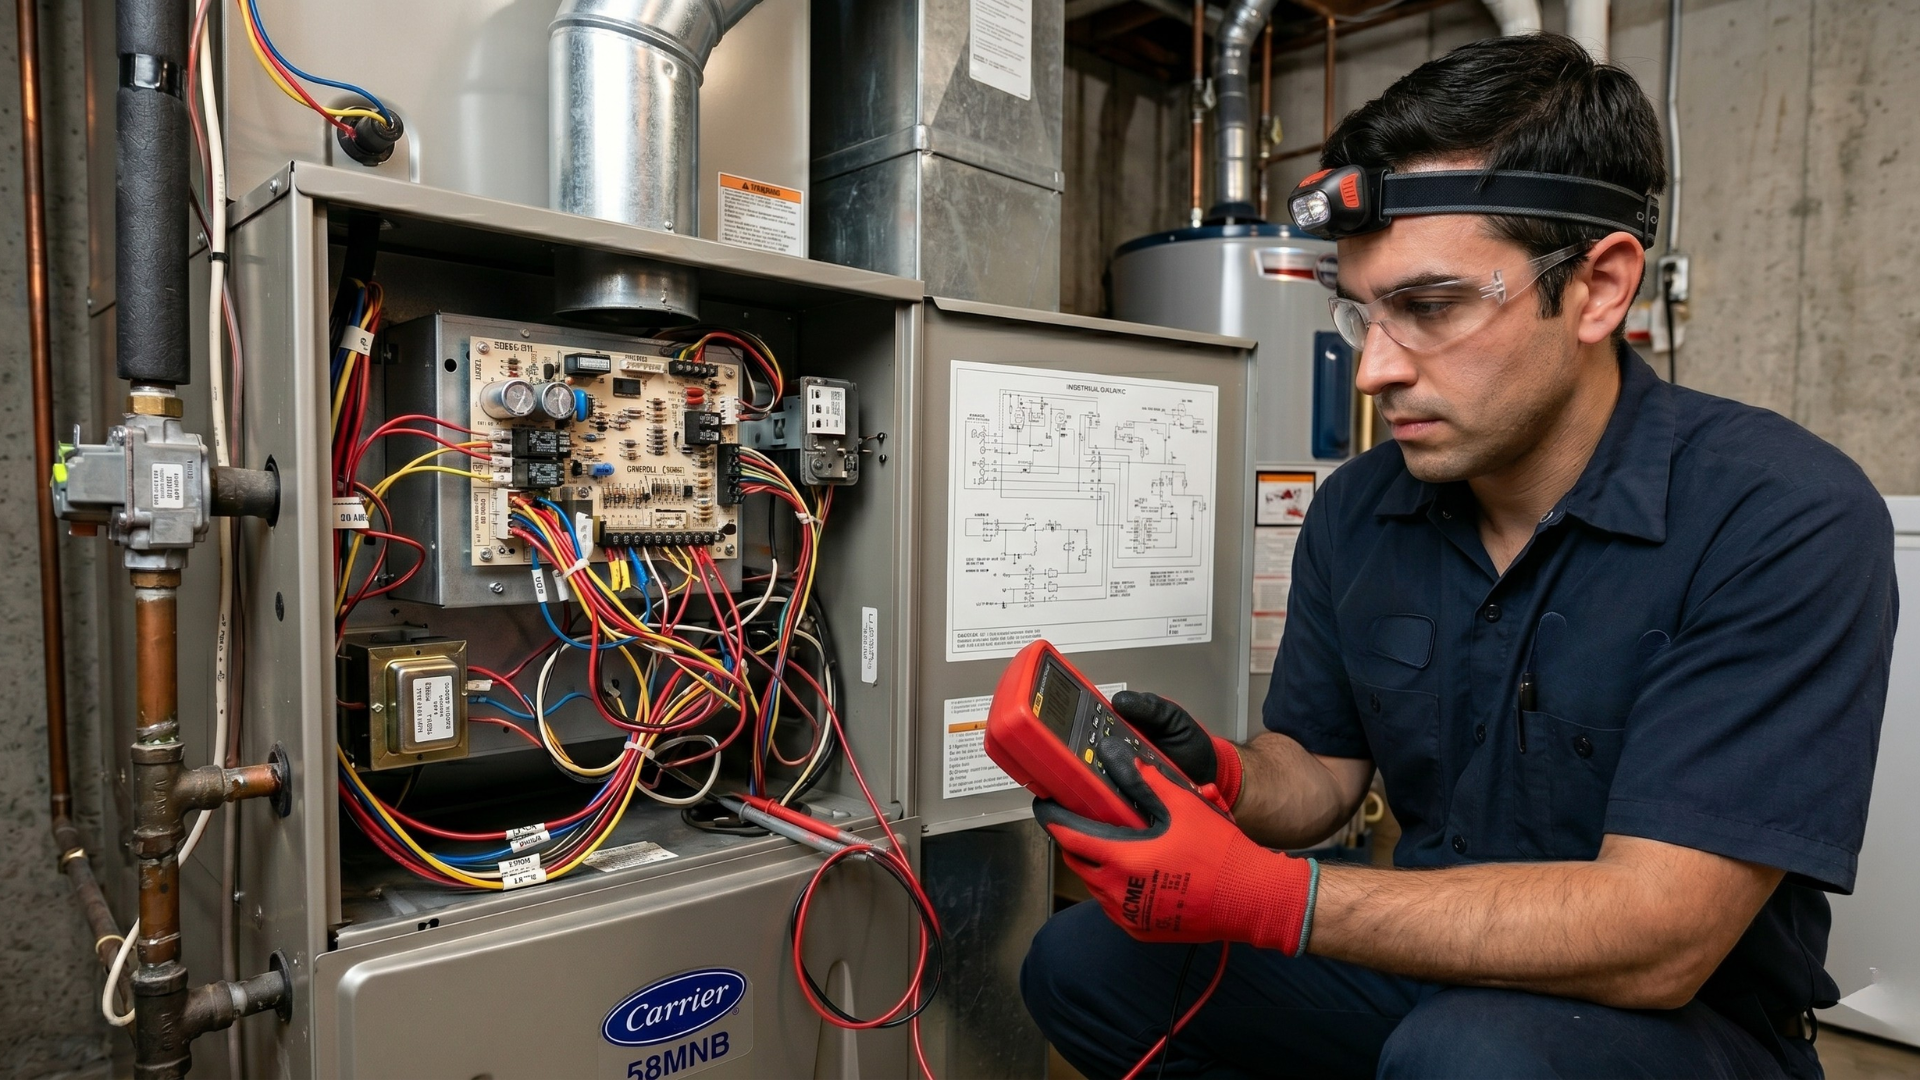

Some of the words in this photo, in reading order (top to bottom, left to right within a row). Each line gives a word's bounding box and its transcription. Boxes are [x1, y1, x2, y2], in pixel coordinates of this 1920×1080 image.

[1122, 876, 1146, 925] ACME
[626, 984, 730, 1032] Carrier
[627, 1031, 730, 1080] 58MNB
